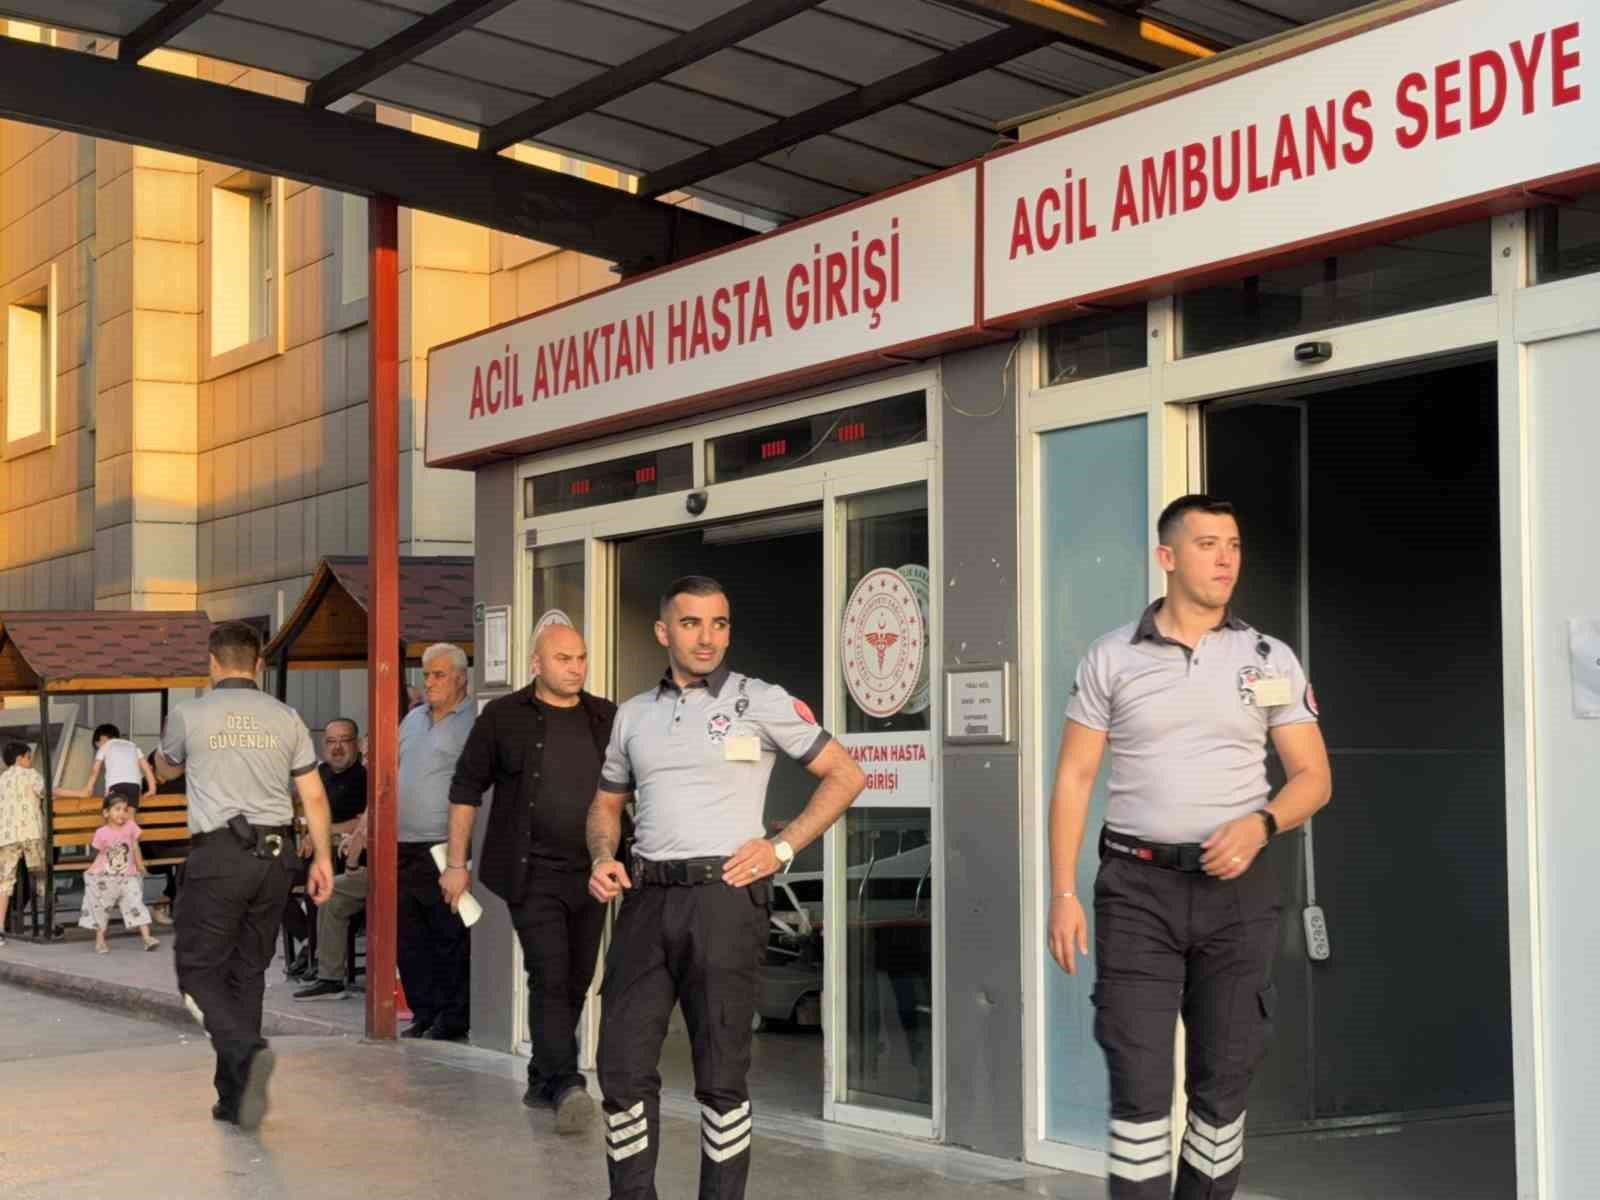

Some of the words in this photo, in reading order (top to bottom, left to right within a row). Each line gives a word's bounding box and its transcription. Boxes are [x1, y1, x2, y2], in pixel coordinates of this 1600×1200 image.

[1008, 167, 1097, 260] ACİL
[1111, 89, 1374, 232] AMBULANS
[1395, 21, 1581, 150] SEDYE
[469, 343, 524, 419] ACİL
[532, 311, 655, 402] AYAKTAN
[667, 275, 772, 363] HASTA
[784, 216, 900, 330] GİRİŞİ
[846, 744, 888, 762] YAKTAN
[891, 743, 926, 761] HASTA
[866, 766, 898, 795] GİRİŞİ
